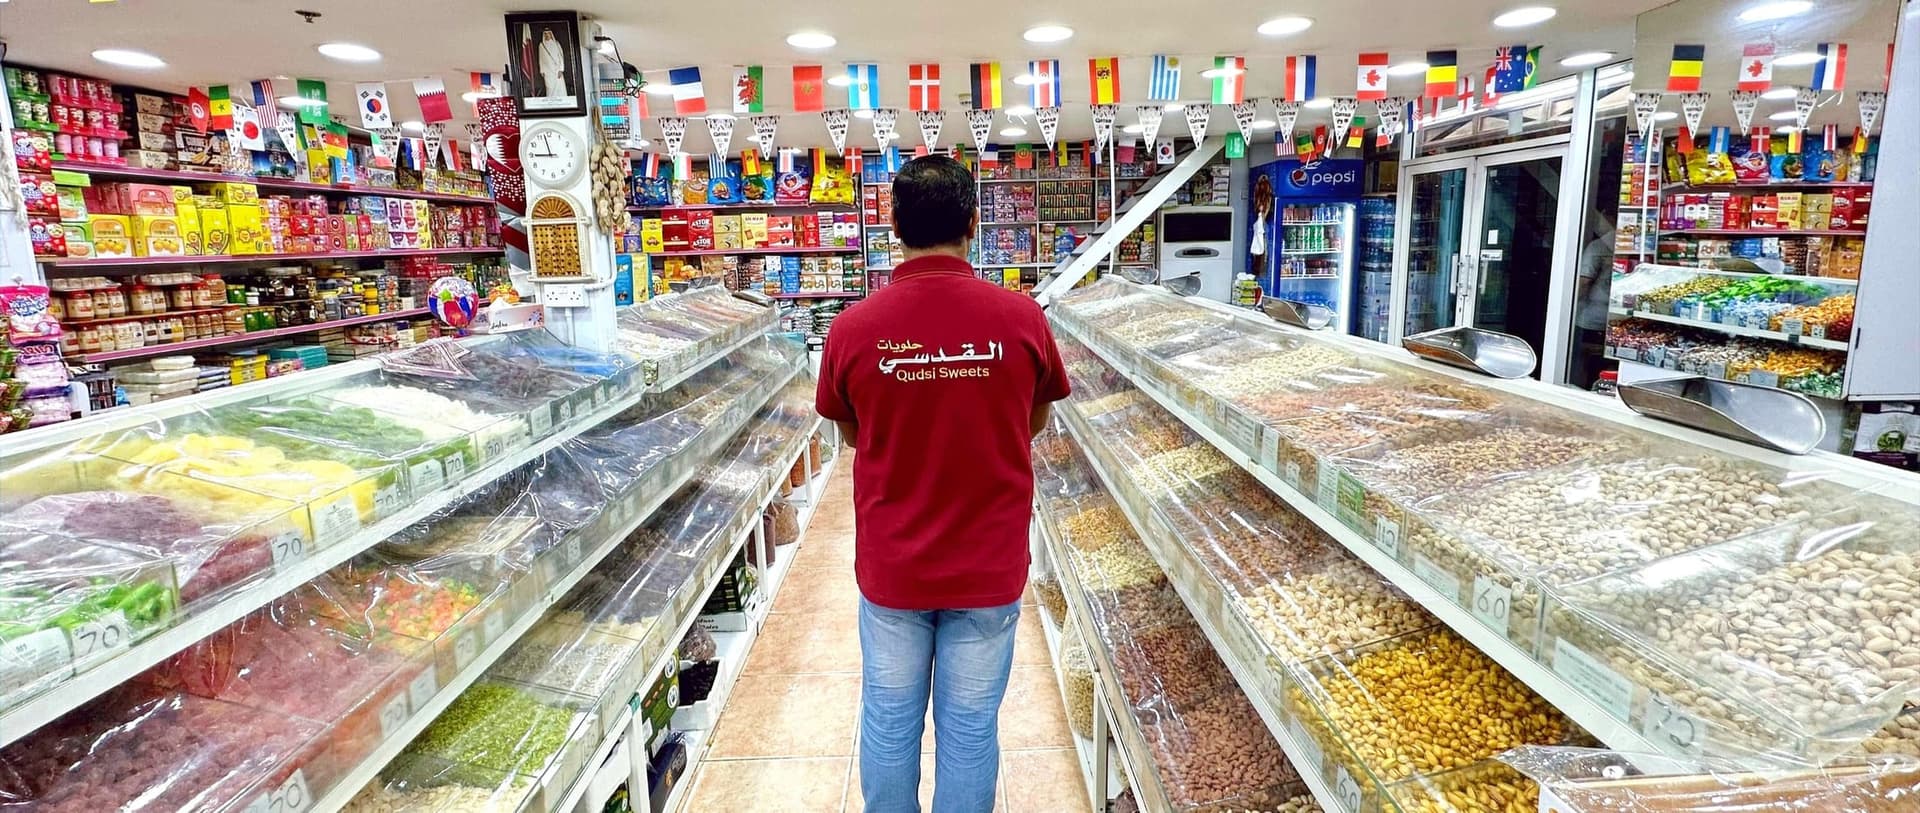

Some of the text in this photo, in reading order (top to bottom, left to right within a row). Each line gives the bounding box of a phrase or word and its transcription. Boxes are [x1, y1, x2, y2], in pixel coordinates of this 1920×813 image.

[1311, 170, 1356, 186] pepsi
[877, 339, 924, 353] حلويات
[879, 340, 1003, 374] القدسي
[896, 366, 990, 383] Qudsi Sweets
[447, 457, 462, 475] 70
[278, 537, 302, 562] 70
[1477, 588, 1506, 619] 60
[79, 624, 120, 654] 70
[1338, 778, 1358, 813] 60
